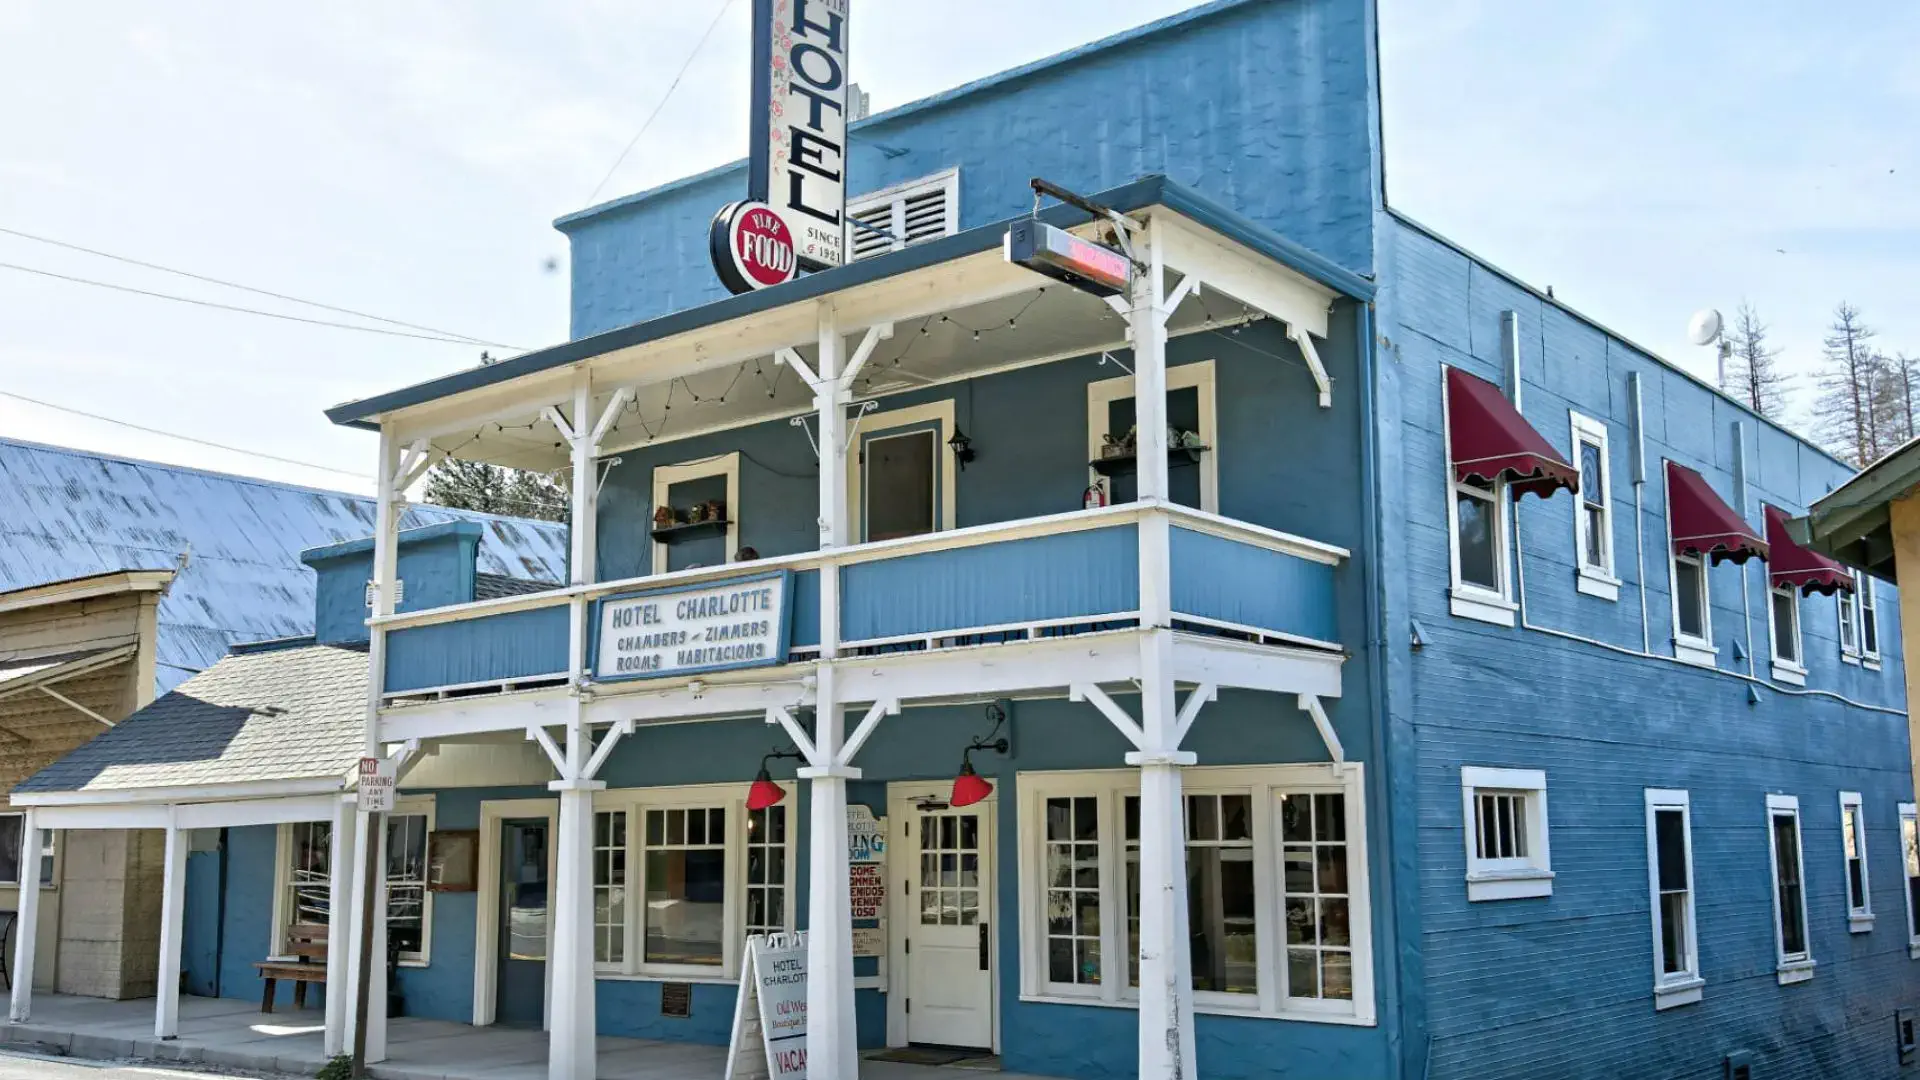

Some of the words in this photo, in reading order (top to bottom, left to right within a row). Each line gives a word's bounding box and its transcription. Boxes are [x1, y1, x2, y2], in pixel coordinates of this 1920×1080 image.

[788, 0, 843, 226] HOTEL
[752, 213, 780, 235] FINE
[807, 227, 839, 247] SINCE
[742, 229, 792, 273] FOOD
[820, 246, 839, 263] 1921
[612, 604, 661, 628] HOTEL
[676, 589, 771, 620] CHARLOTTE
[705, 620, 769, 642] ZIMMERS
[616, 654, 661, 672] ROOMS
[677, 643, 766, 665] HABITACIONS
[360, 759, 376, 773] NO
[361, 776, 392, 787] PARKING
[369, 788, 383, 796] ANY
[366, 797, 384, 806] TIME
[850, 866, 876, 876] COME
[850, 887, 885, 897] ENIDOS
[773, 959, 802, 973] HOTEL
[763, 973, 808, 986] CHARLOTT
[776, 1000, 790, 1015] Old
[776, 1048, 807, 1075] VACA
